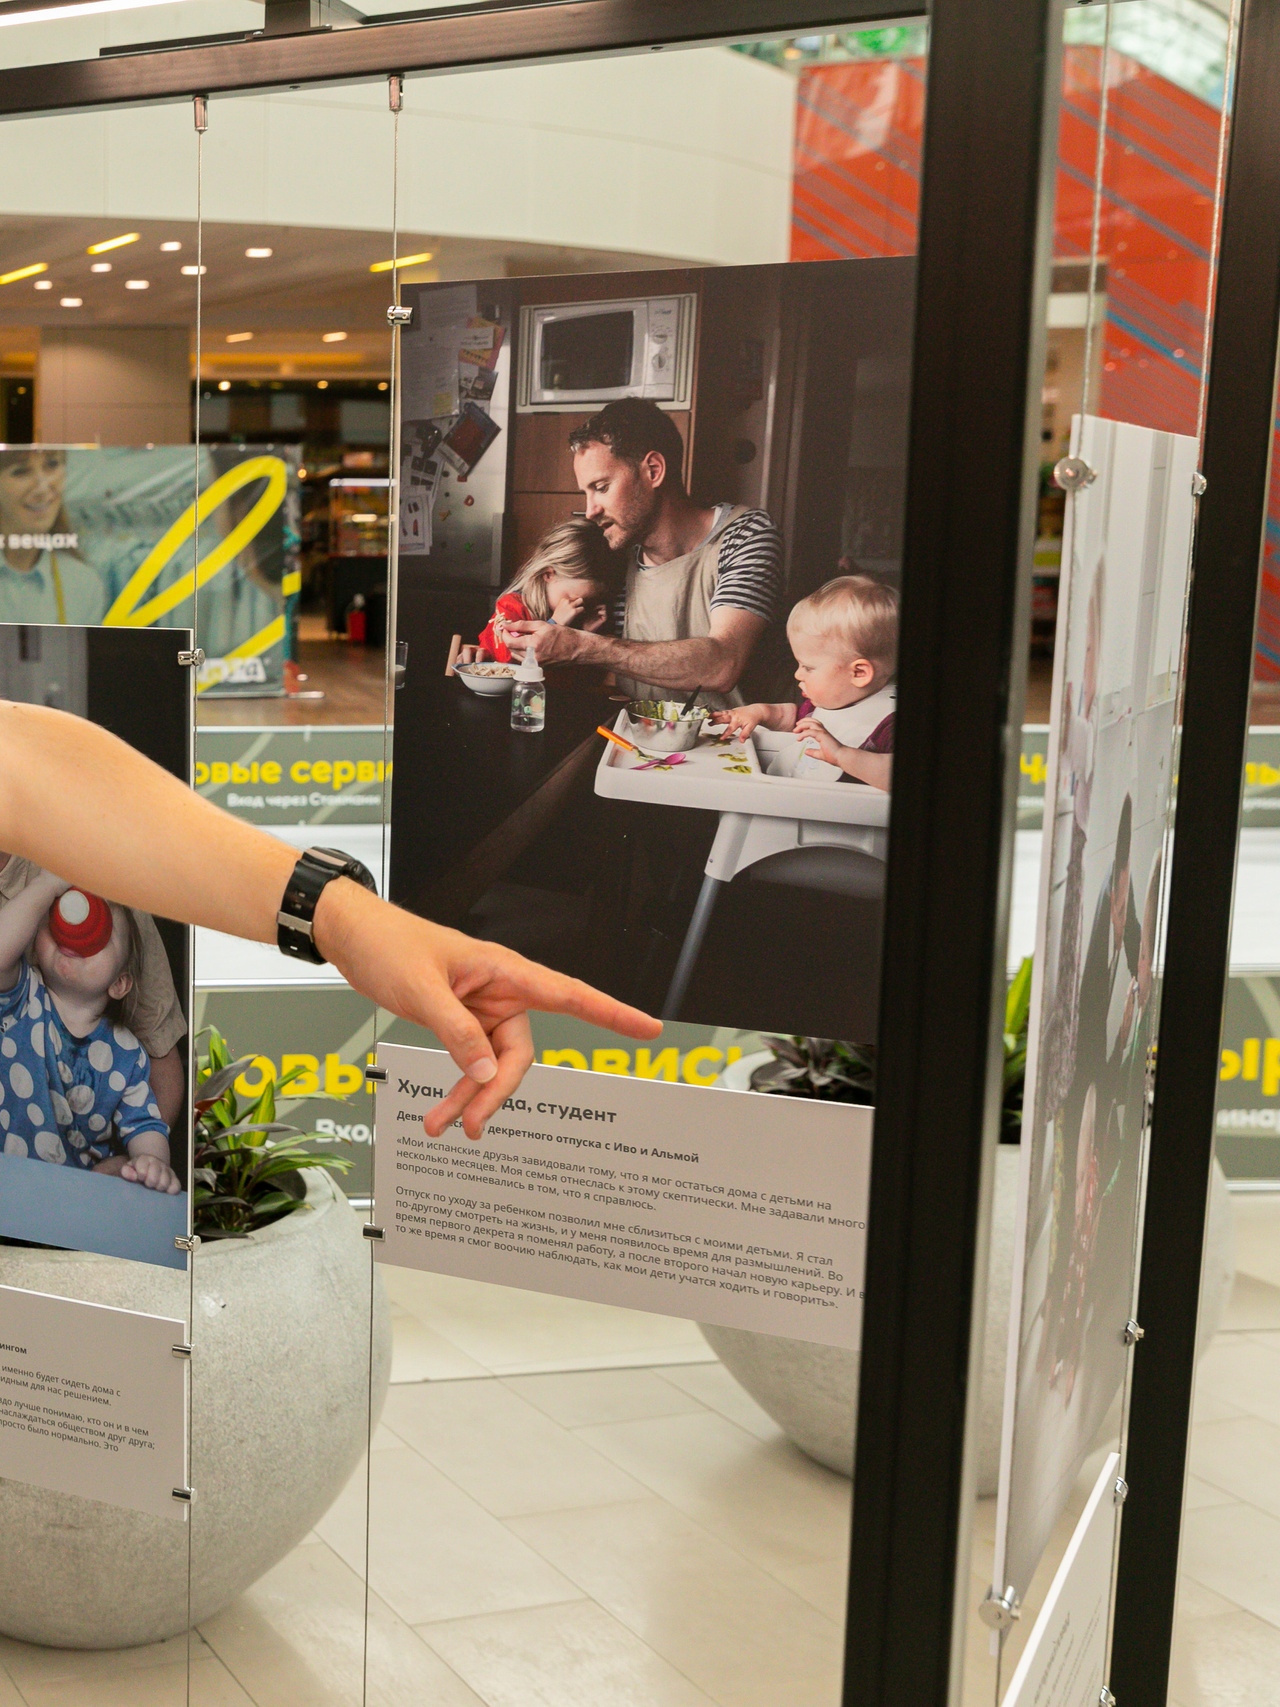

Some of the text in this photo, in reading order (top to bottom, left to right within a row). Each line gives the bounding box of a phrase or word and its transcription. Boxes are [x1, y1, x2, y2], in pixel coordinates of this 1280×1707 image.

[8, 533, 78, 551] вещах
[486, 1124, 554, 1142] декретного
[555, 1134, 602, 1149] отпуска
[603, 1142, 611, 1151] с
[612, 1141, 638, 1155] Иво
[639, 1147, 649, 1156] и
[650, 1147, 700, 1164] Альмой
[535, 1101, 618, 1124] студент
[395, 1135, 832, 1211] «Мои испанские друзья завидовали тому, что я мог остаться дома с детьми на
[395, 1161, 657, 1211] вопросов и сомневались в том, что я справлюсь.
[395, 1149, 865, 1230] несколько месяцев. Моя семья отнеслась к этому скептически. Мне задавали много
[394, 1185, 833, 1267] Отпуск по уходу за ребенком позволил мне сблизиться с моими детьми. Я стал
[394, 1211, 427, 1225] время
[428, 1217, 472, 1232] первого
[472, 1225, 515, 1240] декрета
[516, 1232, 524, 1241] я
[525, 1234, 574, 1250] поменял
[575, 1243, 616, 1259] работу,
[618, 1250, 626, 1259] а
[627, 1251, 662, 1265] после
[663, 1257, 709, 1273] второго
[711, 1265, 747, 1279] начал
[749, 1272, 789, 1287] новую
[790, 1279, 843, 1298] карьеру.
[845, 1286, 856, 1298] И
[395, 1199, 844, 1282] по-другому смотреть на жизнь, и у меня появилось время для размышлений. Во
[394, 1224, 839, 1309] то же время я смог воочию наблюдать, как мои дети учатся ходить и говорить».
[1, 1364, 35, 1378] именно
[35, 1370, 60, 1384] будет
[60, 1377, 91, 1391] сидеть
[90, 1384, 115, 1396] дома
[115, 1389, 121, 1397] с
[13, 1400, 41, 1413] лучше
[42, 1406, 85, 1424] понимаю,
[86, 1416, 102, 1426] кто
[102, 1420, 115, 1429] он
[115, 1423, 123, 1431] и
[123, 1424, 130, 1433] в
[130, 1426, 149, 1437] чем
